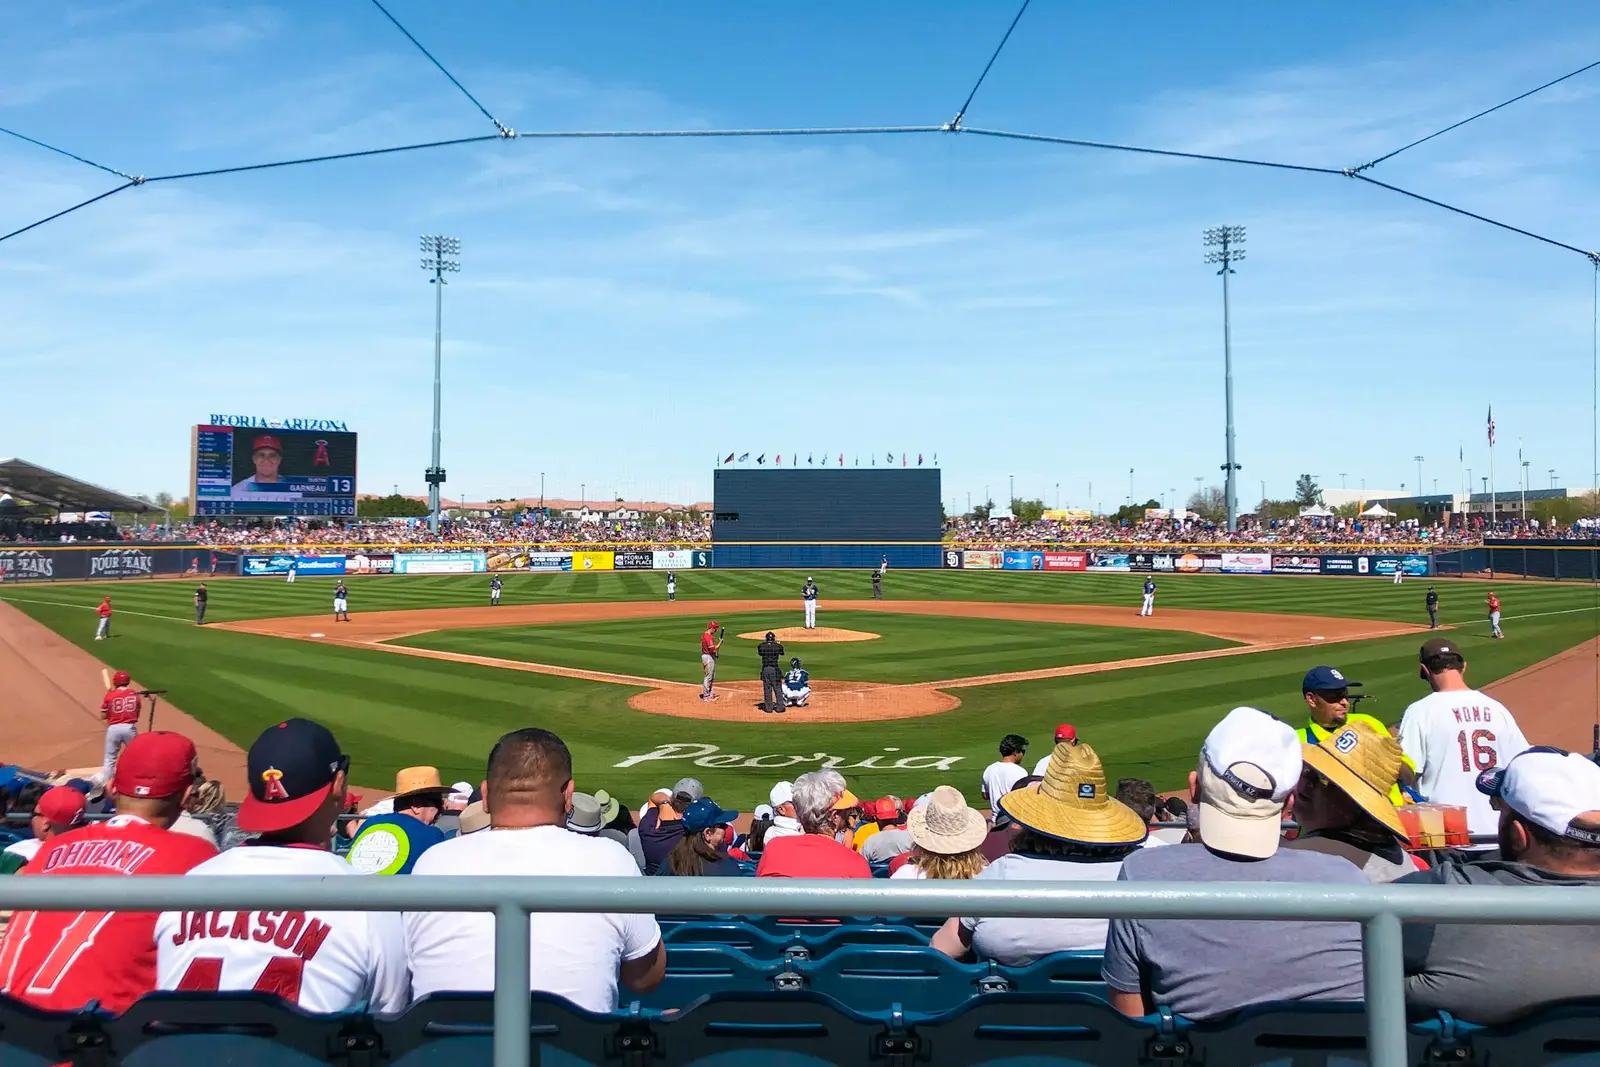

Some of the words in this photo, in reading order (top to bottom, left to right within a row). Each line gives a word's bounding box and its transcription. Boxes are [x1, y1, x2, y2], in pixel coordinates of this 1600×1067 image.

[210, 413, 268, 427] PEORIA
[284, 417, 349, 432] ARIZONA
[289, 484, 327, 492] GARNEAU
[332, 479, 351, 492] 13
[90, 557, 120, 575] FOUR
[297, 560, 337, 569] Southwest
[112, 696, 137, 714] 85
[1451, 705, 1492, 723] WONG
[612, 743, 966, 771] Peoria
[1457, 728, 1497, 773] 16
[42, 839, 156, 876] OHTANI
[172, 911, 333, 962] JACKSON
